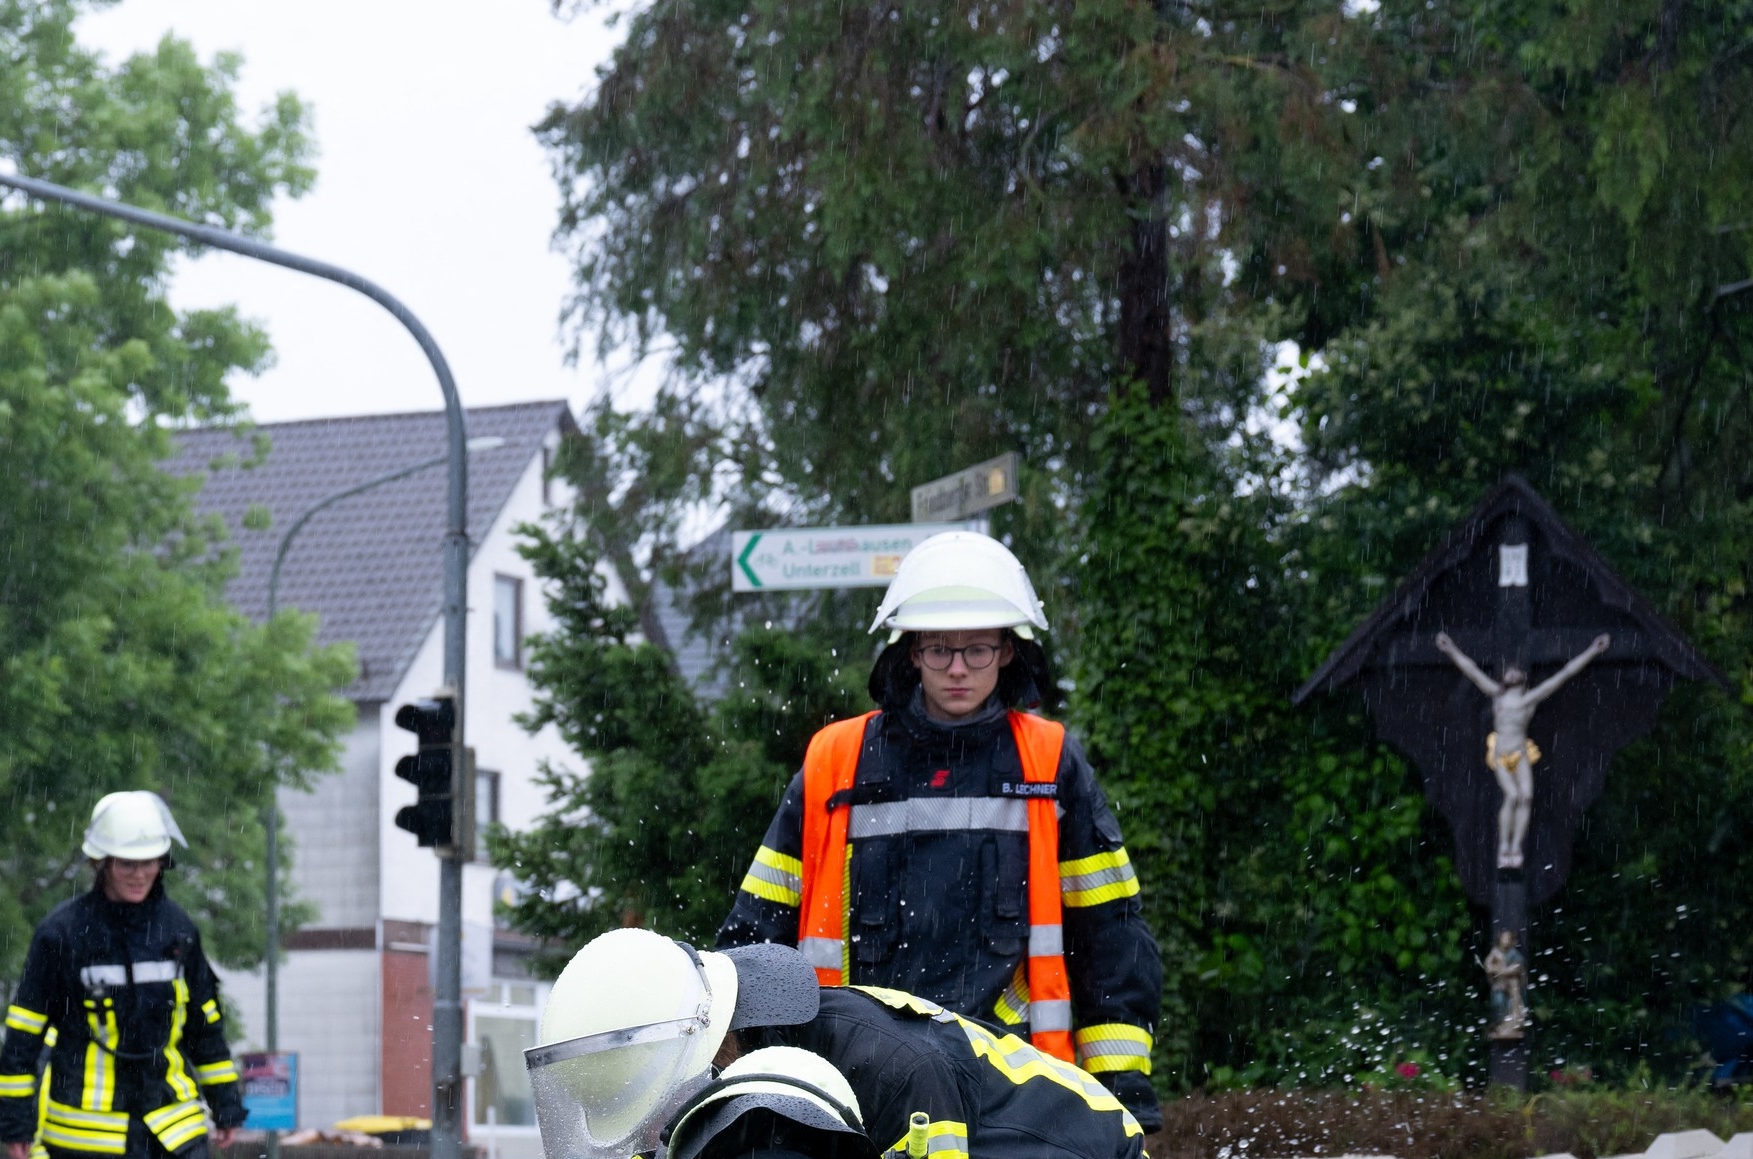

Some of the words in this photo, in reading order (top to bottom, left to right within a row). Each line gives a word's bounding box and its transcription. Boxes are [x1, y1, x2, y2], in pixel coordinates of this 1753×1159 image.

[782, 560, 861, 579] Unterzell
[1002, 782, 1013, 794] B.
[1015, 784, 1058, 795] LECHNER
